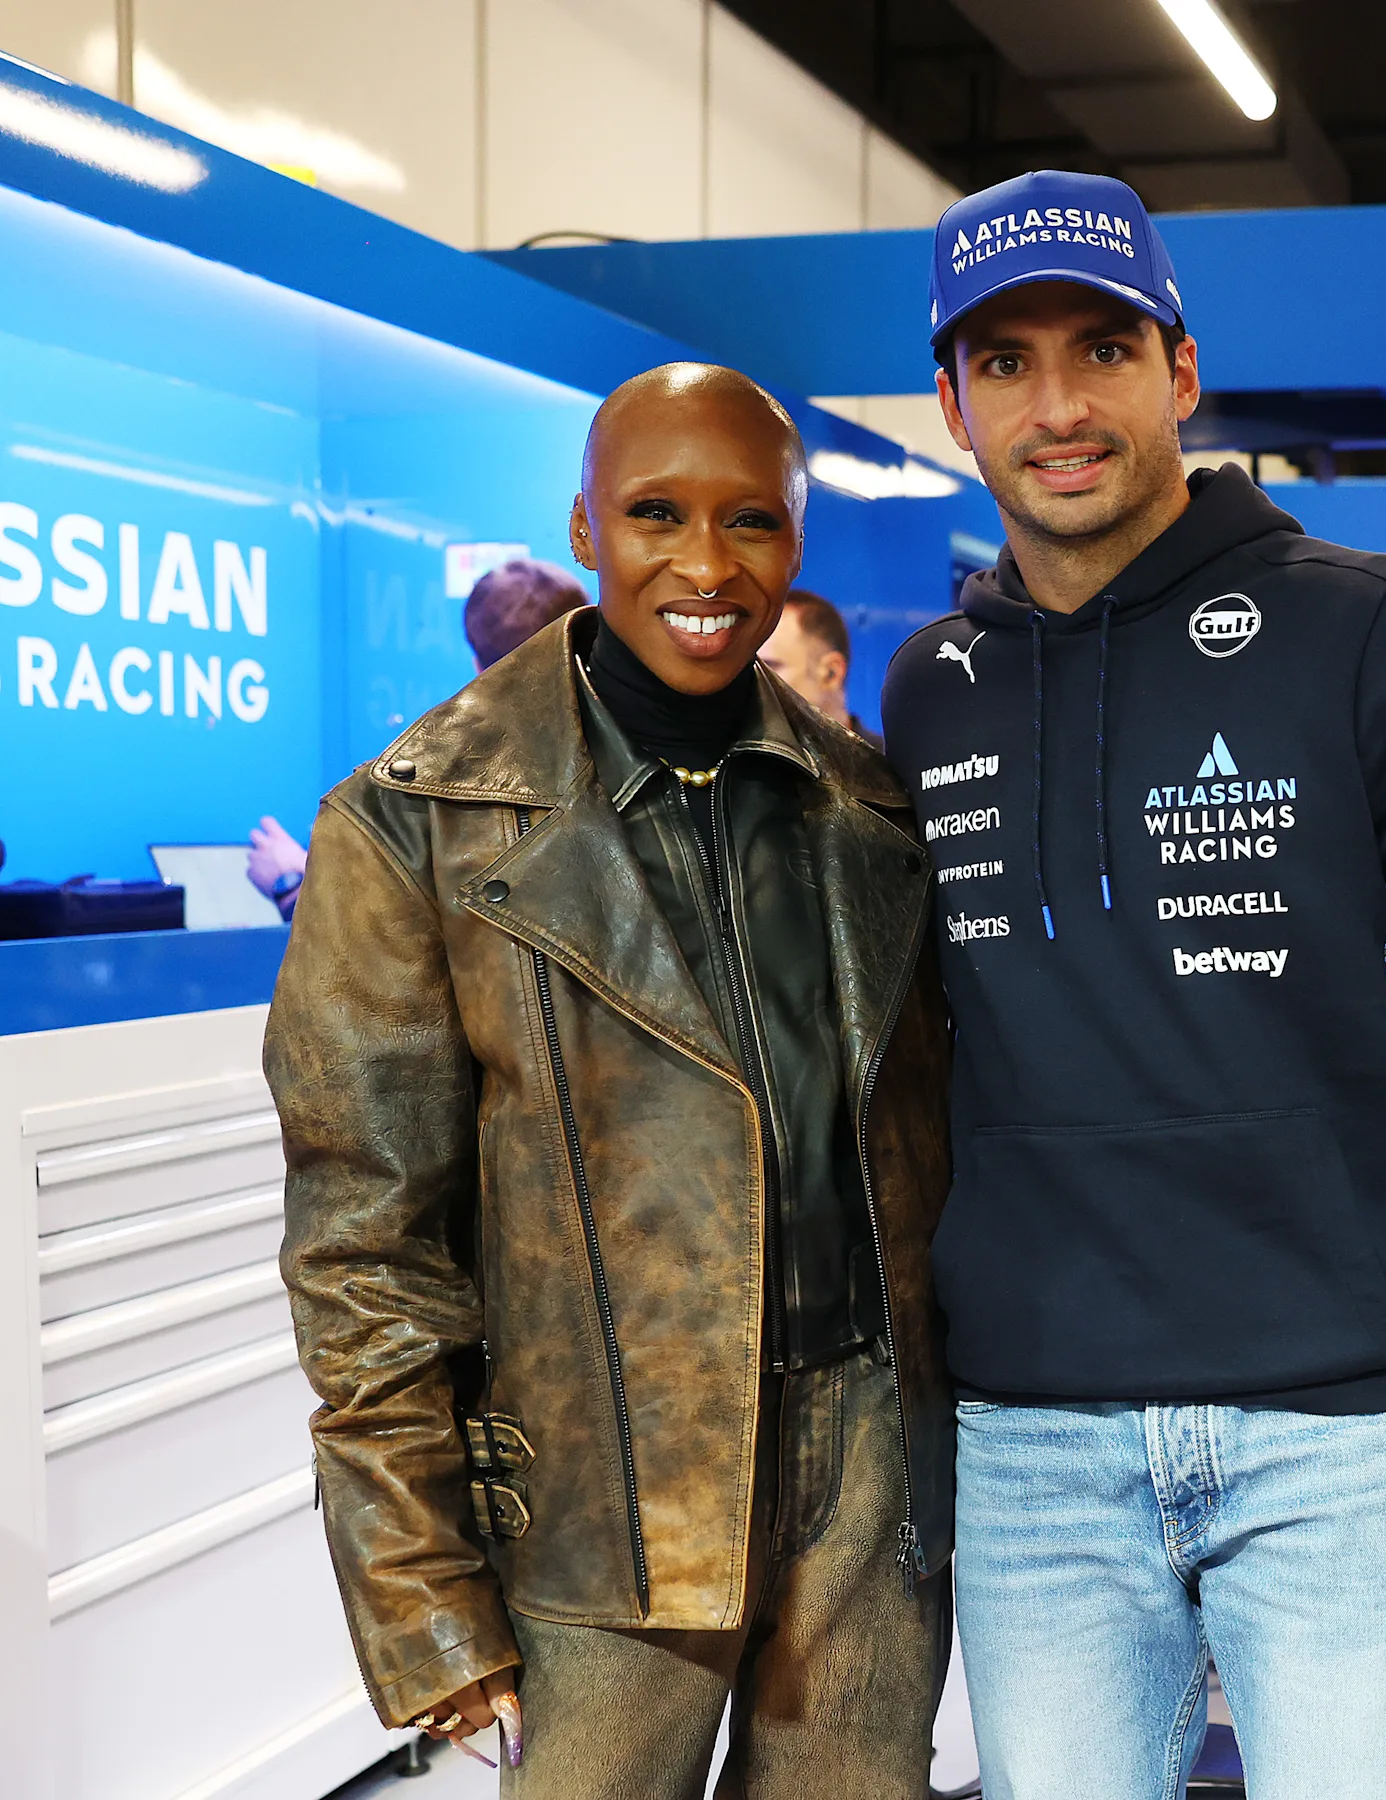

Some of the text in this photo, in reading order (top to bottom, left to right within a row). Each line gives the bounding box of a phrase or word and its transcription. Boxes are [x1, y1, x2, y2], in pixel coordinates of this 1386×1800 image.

[974, 208, 1132, 246] ATLASSIAN
[952, 229, 1135, 276] WILLIAMS RACING
[0, 501, 268, 637] SSIAN
[1194, 616, 1256, 635] Gulf
[17, 635, 269, 723] RACING
[921, 754, 999, 790] KOMATSU
[1144, 778, 1297, 809] ATLASSIAN
[1144, 805, 1295, 836] WILLIAMS
[1161, 835, 1278, 864] RACING
[938, 860, 1003, 884] MYPROTEIN
[1157, 891, 1289, 920] DURACELL
[1173, 947, 1289, 978] betway
